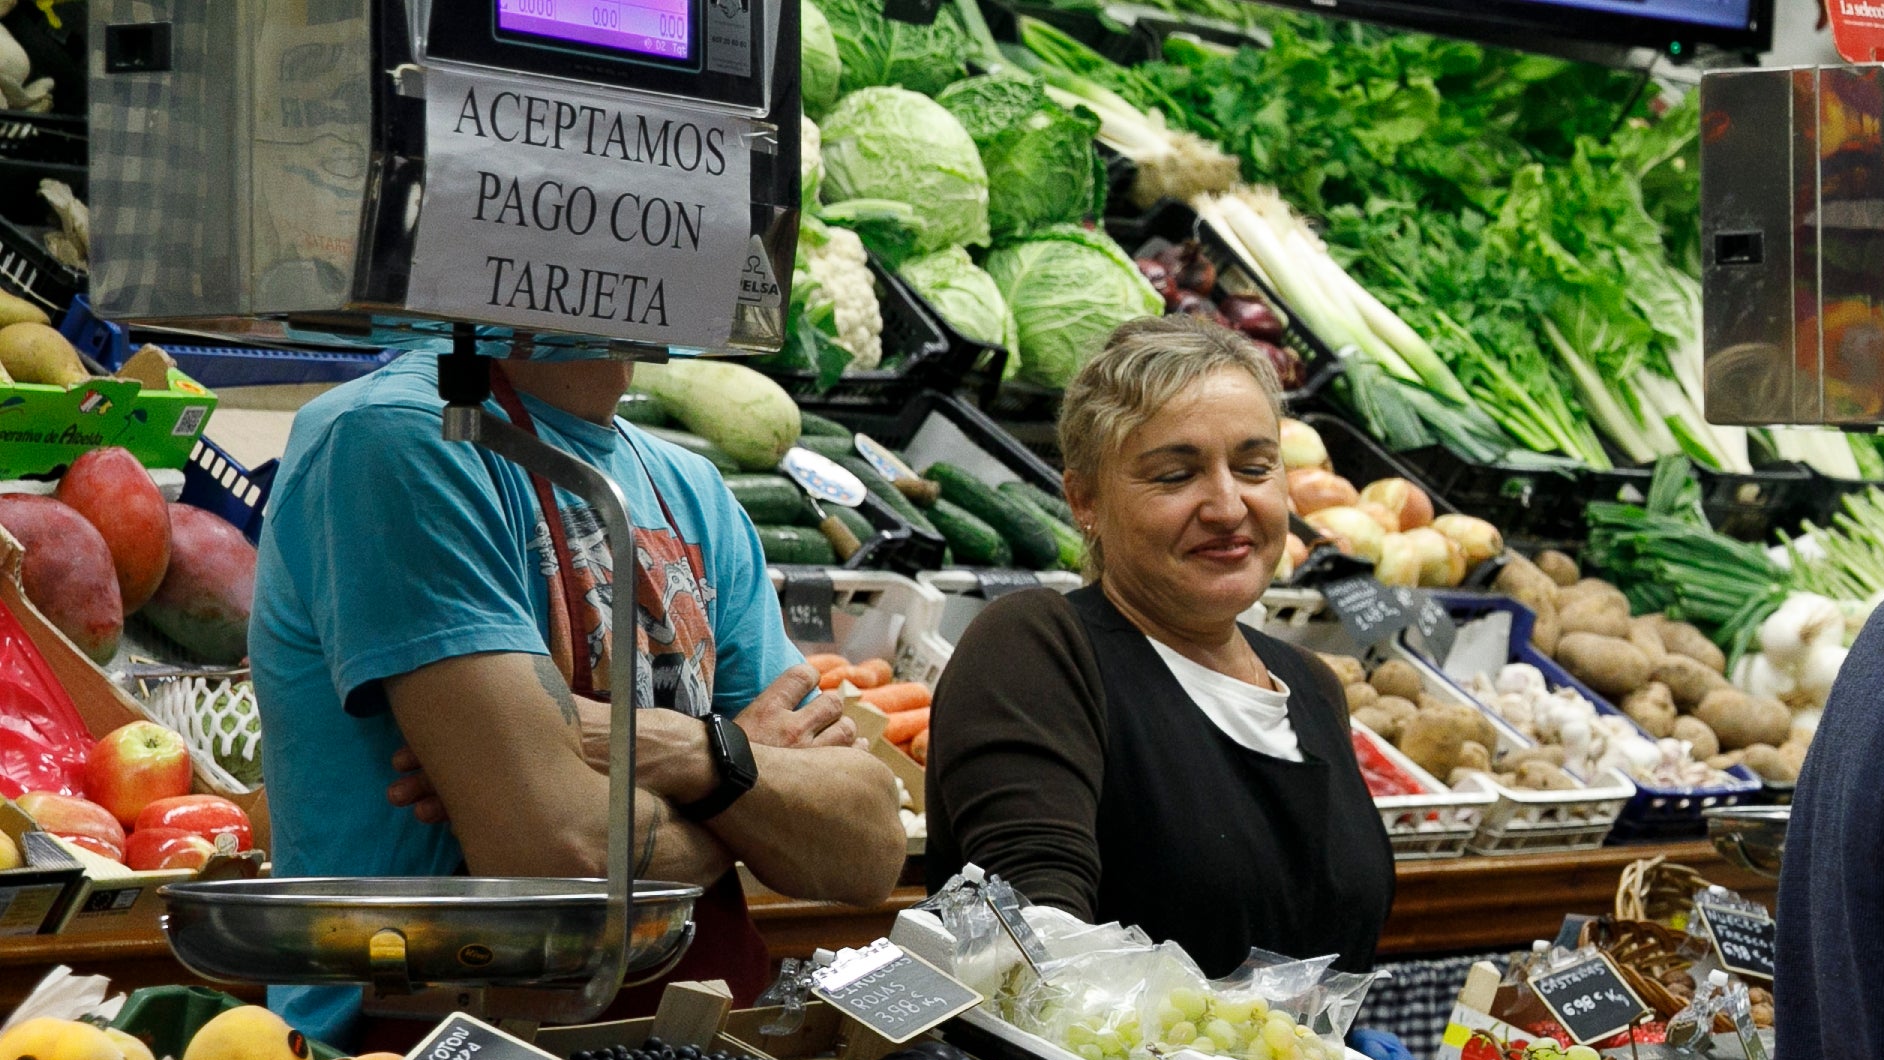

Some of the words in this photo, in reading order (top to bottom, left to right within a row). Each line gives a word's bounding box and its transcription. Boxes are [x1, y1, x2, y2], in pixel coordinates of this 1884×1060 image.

[453, 86, 726, 176] ACEPTAMOS
[472, 170, 597, 236] PAGO
[610, 192, 705, 251] CON
[486, 255, 670, 328] TARJETA
[850, 981, 906, 1011] ROJAS
